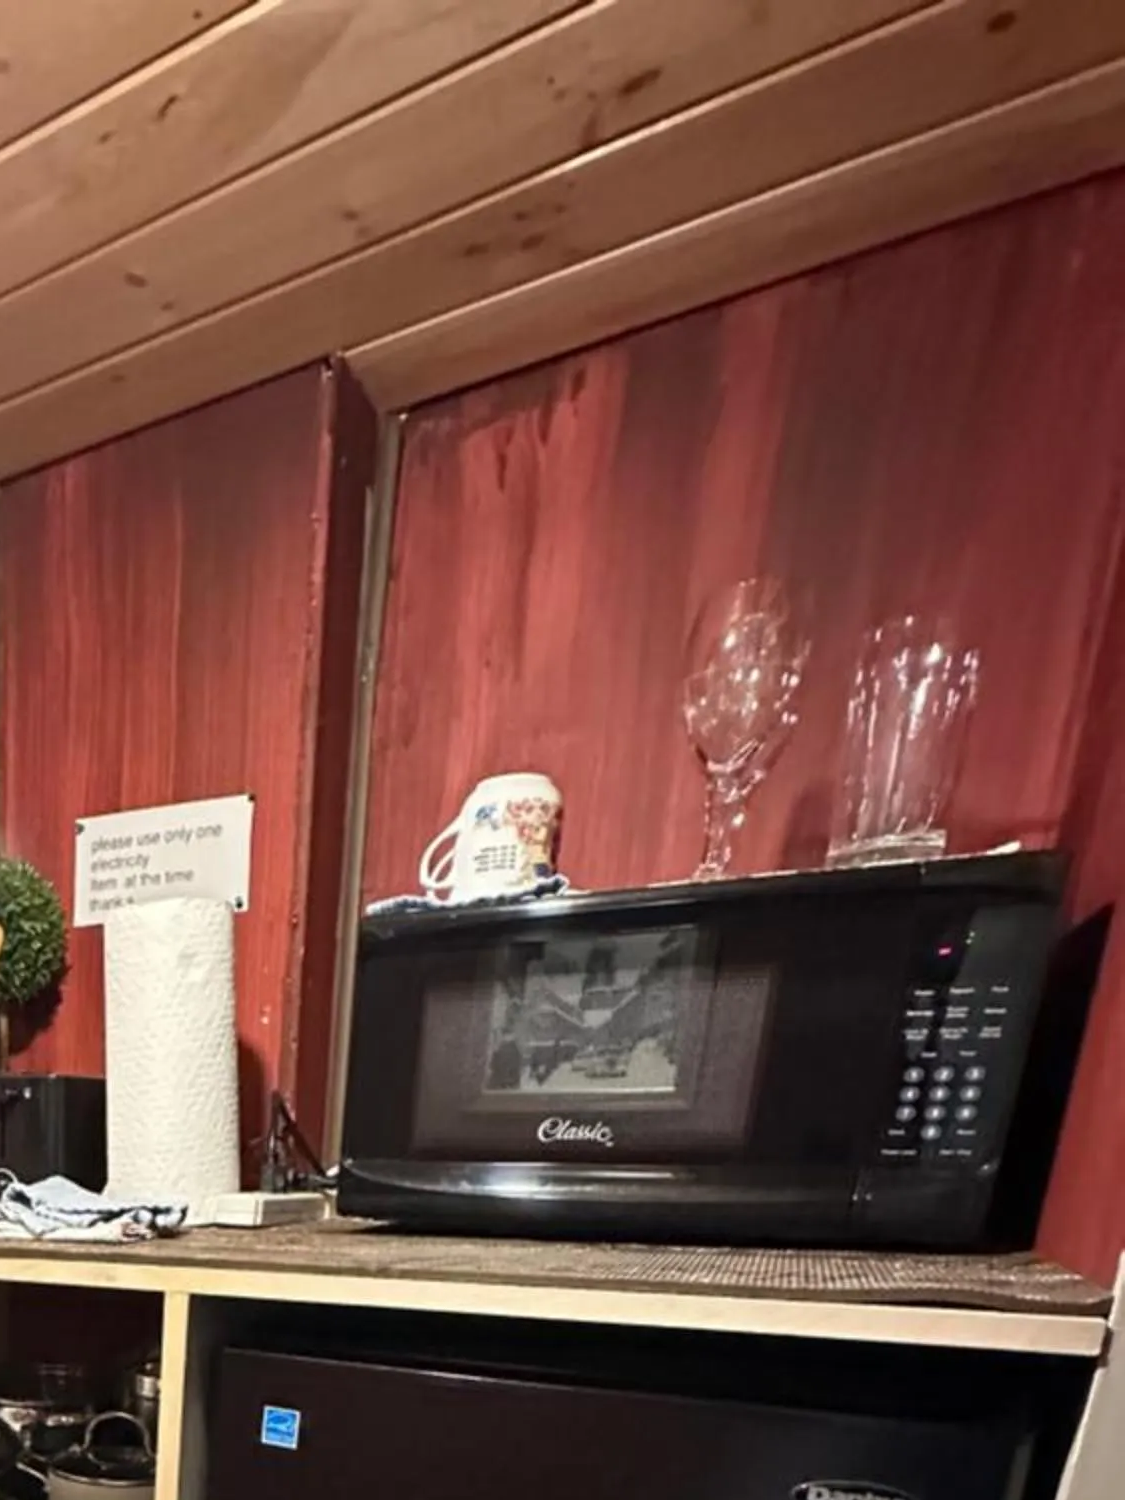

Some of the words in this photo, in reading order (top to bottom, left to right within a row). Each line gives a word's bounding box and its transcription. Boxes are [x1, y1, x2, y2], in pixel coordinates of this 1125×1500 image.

[91, 835, 133, 853] please
[137, 831, 161, 847] use
[163, 824, 193, 846] only
[196, 823, 223, 840] one
[140, 872, 161, 886] the
[165, 869, 194, 884] time
[537, 1116, 613, 1143] Classic
